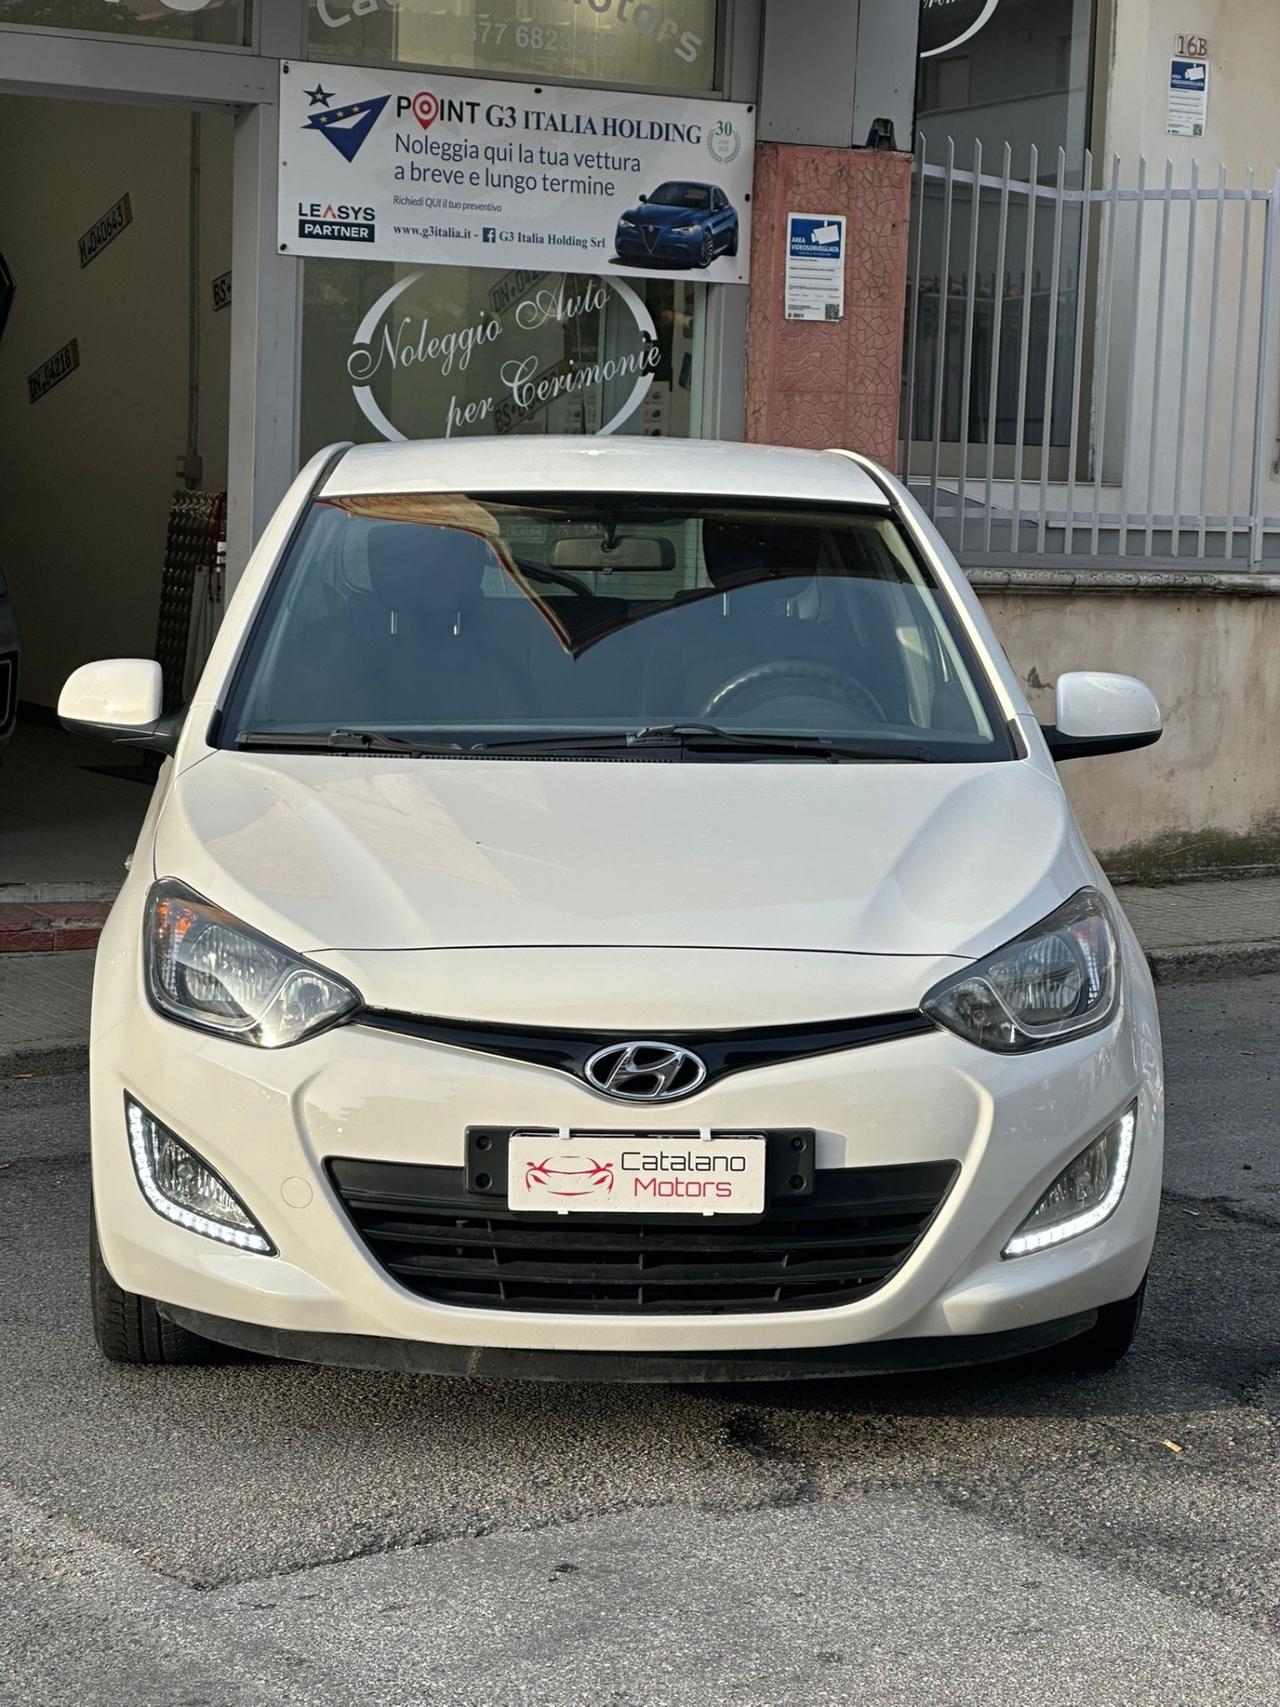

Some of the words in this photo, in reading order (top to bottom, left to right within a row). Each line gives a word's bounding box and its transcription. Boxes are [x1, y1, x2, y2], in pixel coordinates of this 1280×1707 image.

[1178, 35, 1207, 56] 16B
[397, 93, 481, 127] POINT
[485, 104, 517, 129] G3
[523, 110, 597, 137] ITALIA
[602, 117, 702, 145] HOLDING
[716, 120, 733, 137] 30
[395, 132, 479, 162] Noleggia
[484, 143, 513, 165] qui
[518, 144, 534, 164] la
[539, 147, 569, 167] tua
[574, 151, 641, 172] vettura
[394, 165, 405, 180] a
[410, 161, 464, 185] breve
[469, 171, 480, 186] e
[485, 168, 537, 194] lungo
[542, 173, 615, 197] termine
[298, 202, 376, 222] LEASYS
[393, 195, 424, 207] Richiedi
[425, 197, 442, 208] QUI
[449, 200, 461, 209] tuo
[462, 201, 502, 212] preventivo
[304, 223, 369, 239] PARTNER
[393, 224, 472, 240] www.g3italia.it
[499, 230, 514, 243] G3
[518, 232, 545, 244] Italia
[548, 234, 588, 250] Holding
[590, 237, 606, 248] Srl
[348, 310, 502, 380] Noleggio
[515, 272, 609, 330] Auto
[446, 395, 494, 438] per
[500, 336, 662, 409] Cerimonie
[621, 1151, 746, 1172] Catalano
[634, 1177, 732, 1198] Motors
